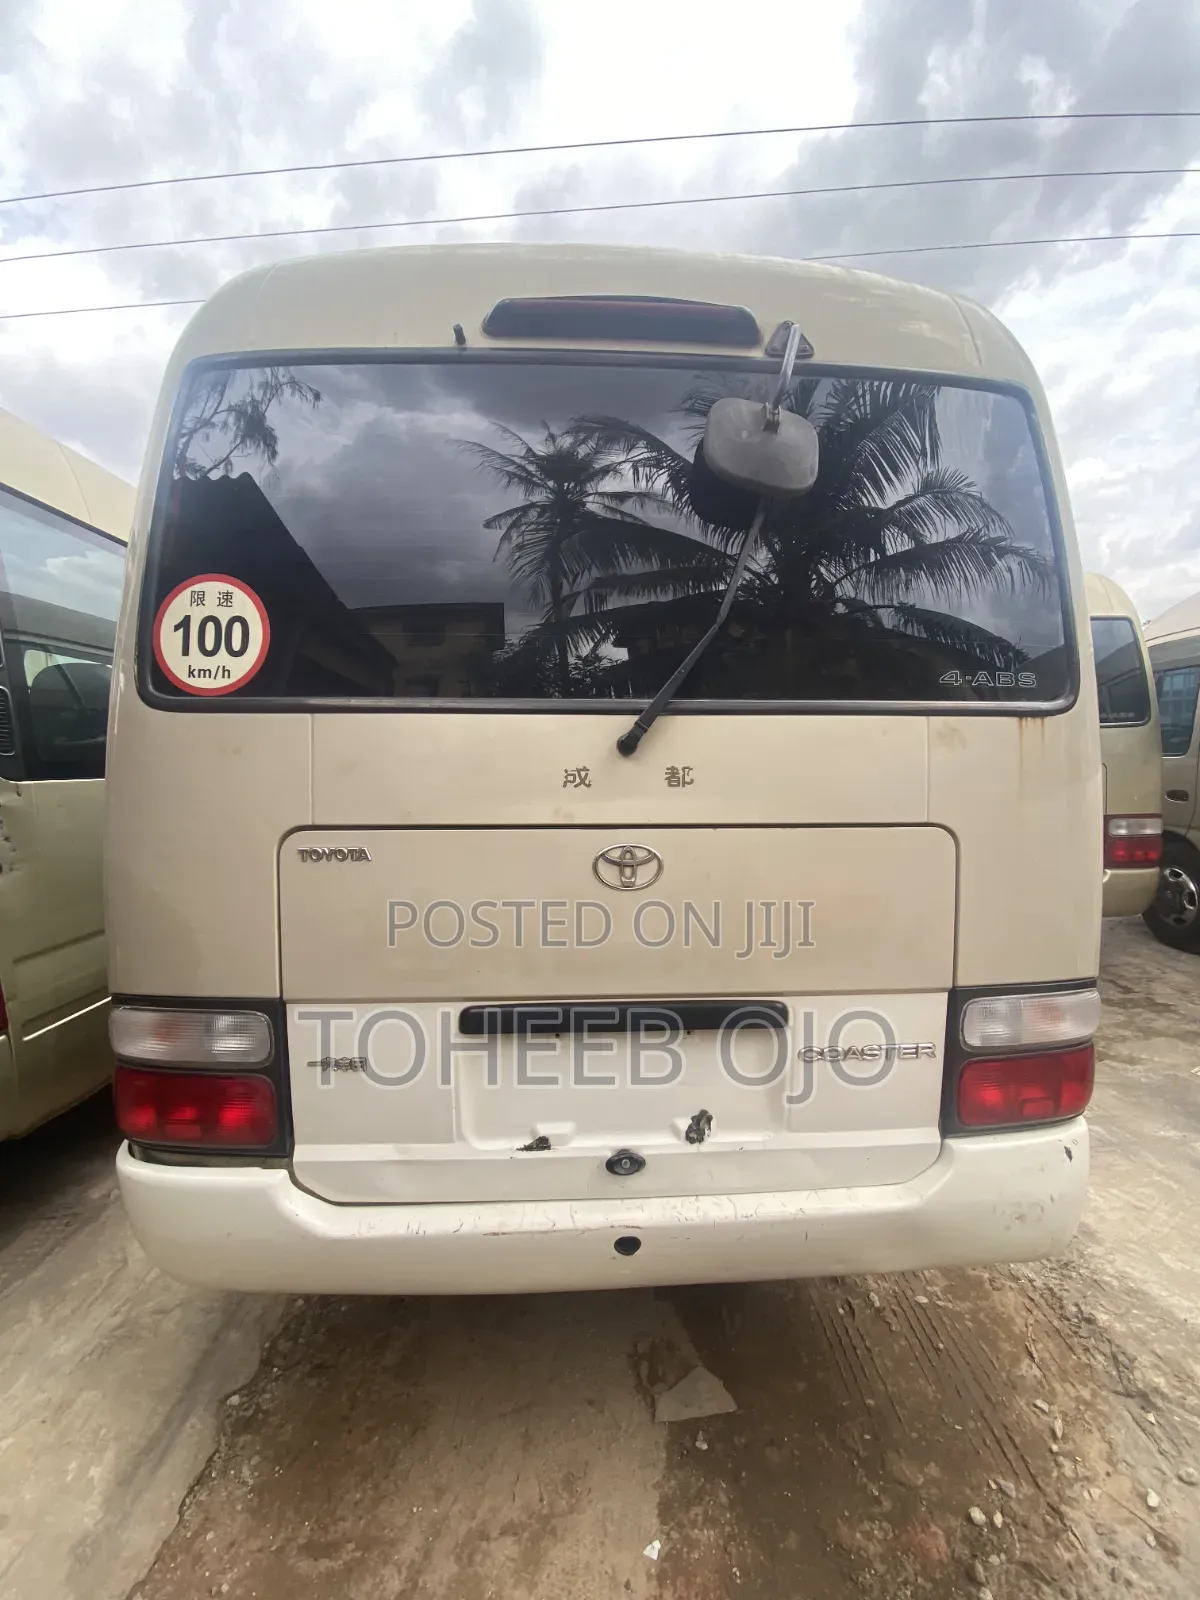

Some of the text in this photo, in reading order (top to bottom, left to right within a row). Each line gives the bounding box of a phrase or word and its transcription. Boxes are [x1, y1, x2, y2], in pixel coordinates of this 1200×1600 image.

[190, 590, 233, 607] 限速
[173, 614, 250, 658] 100
[188, 664, 231, 680] km/h
[297, 847, 372, 863] TOYOTA
[798, 1041, 937, 1063] COASTER
